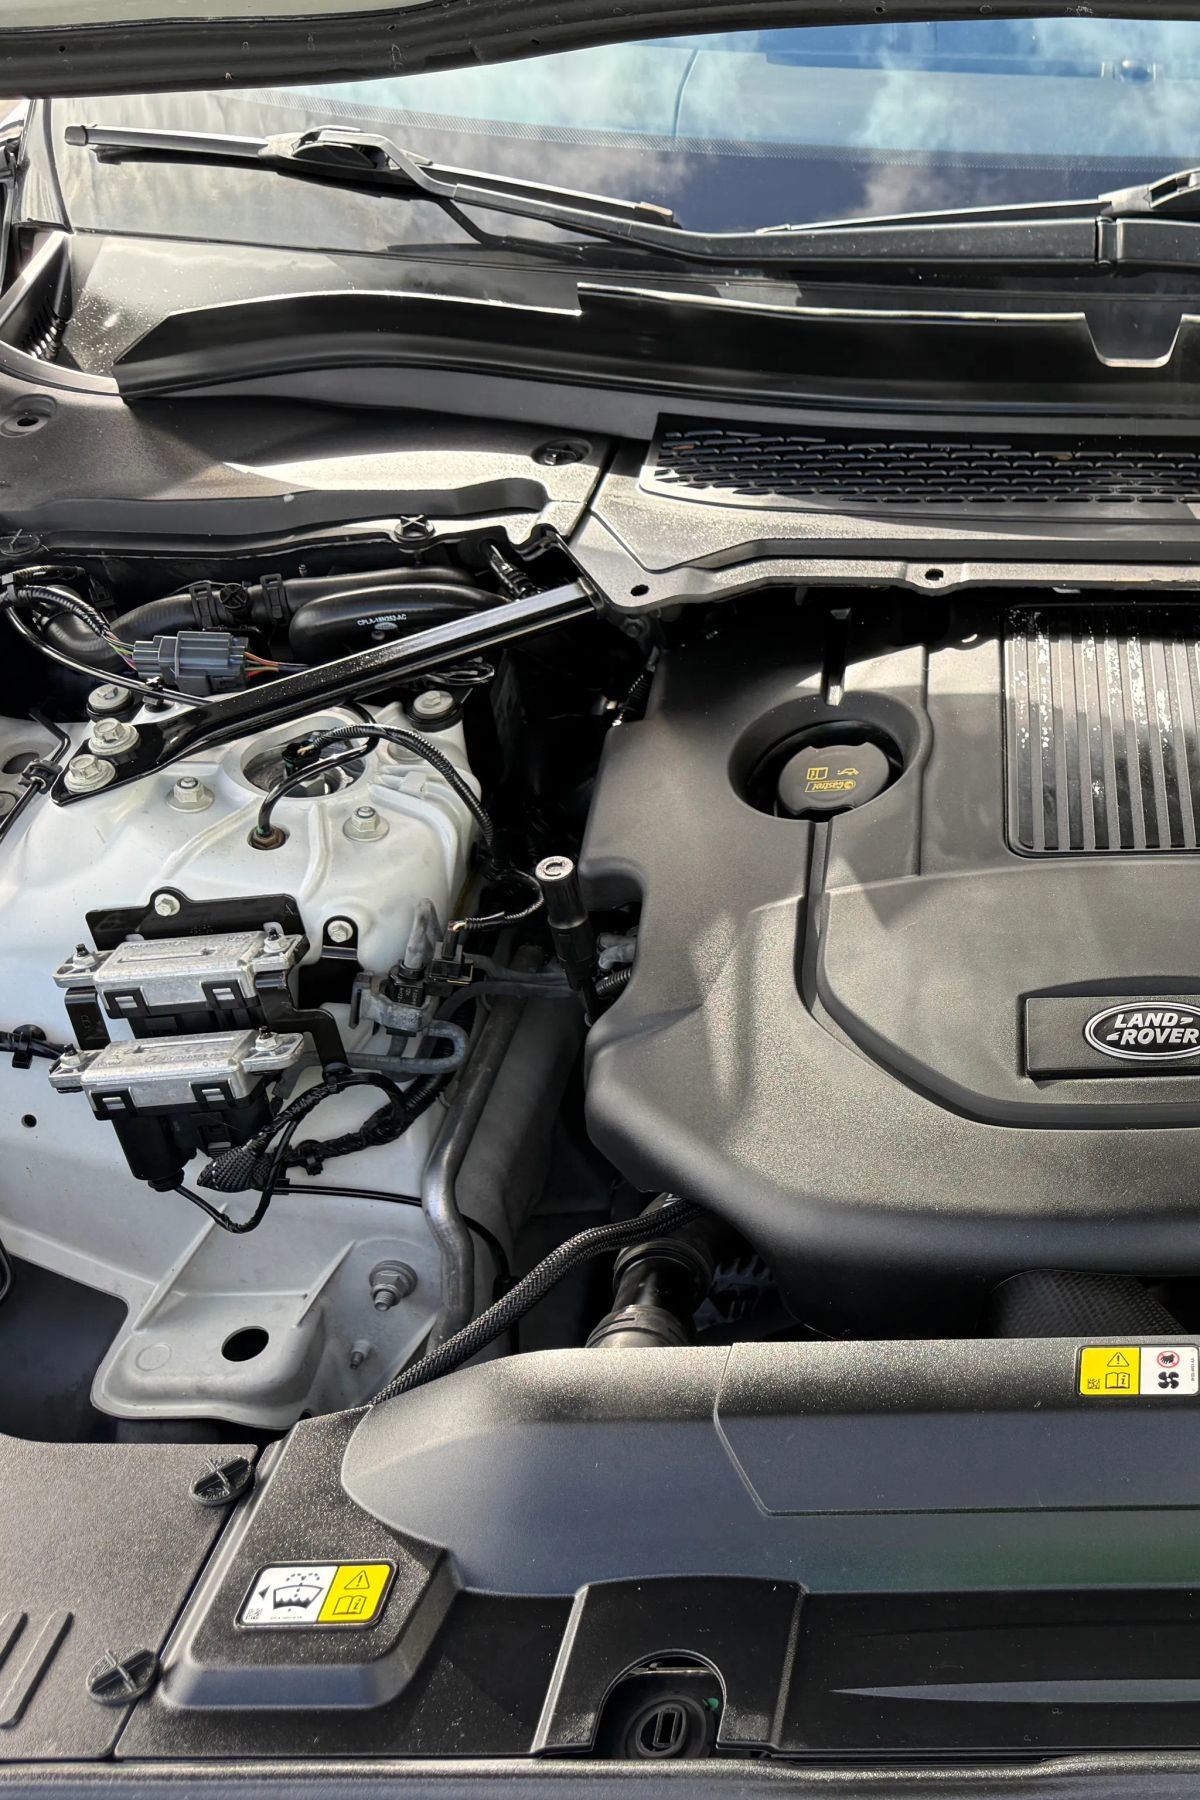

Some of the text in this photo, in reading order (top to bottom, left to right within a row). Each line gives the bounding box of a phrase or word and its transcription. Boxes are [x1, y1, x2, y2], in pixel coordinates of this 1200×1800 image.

[812, 781, 844, 791] Castrol
[1114, 1012, 1178, 1029] LAND
[1120, 1028, 1200, 1046] ROVER
